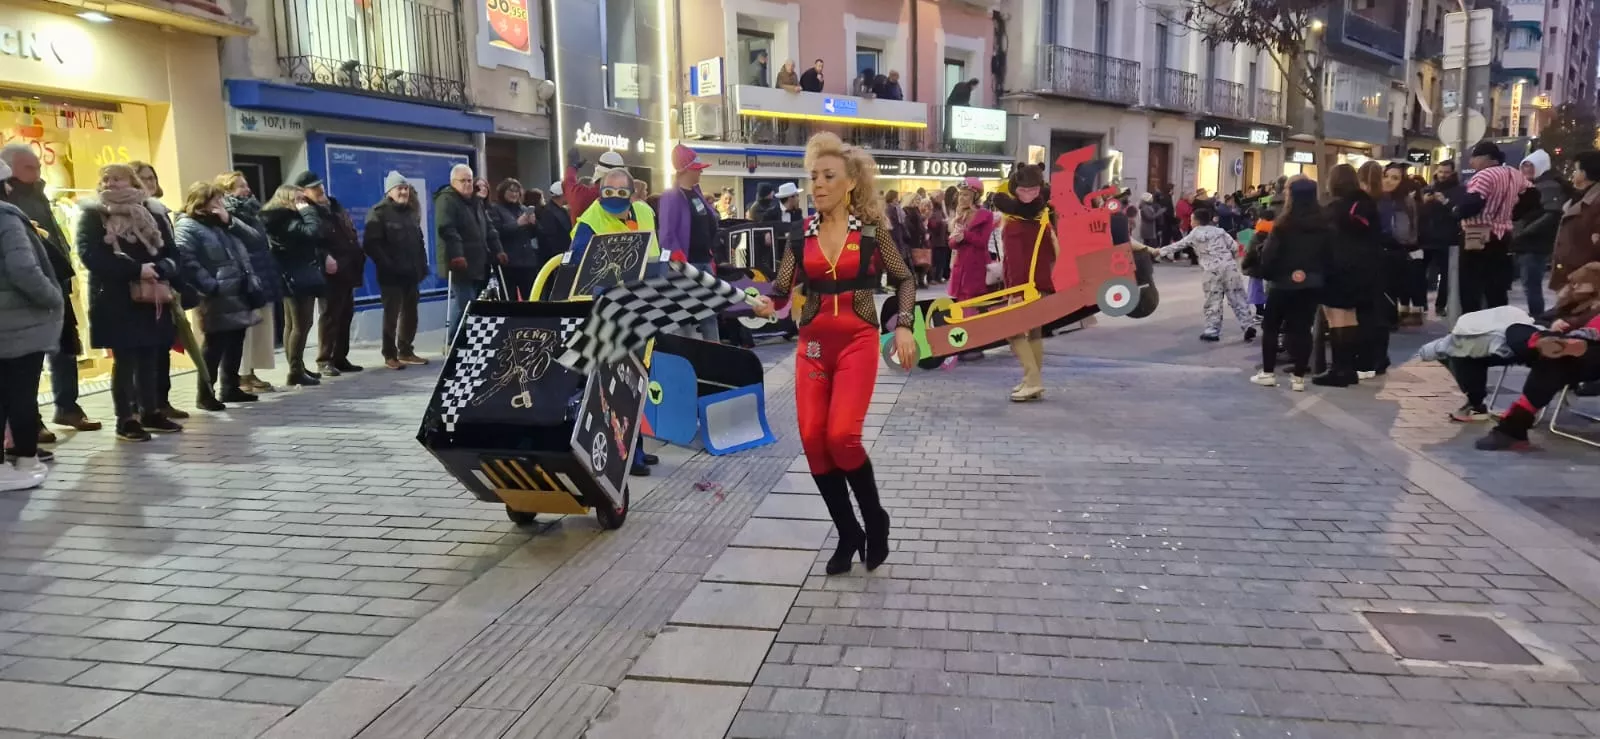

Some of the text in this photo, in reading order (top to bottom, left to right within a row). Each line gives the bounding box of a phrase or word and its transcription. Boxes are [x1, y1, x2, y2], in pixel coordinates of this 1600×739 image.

[1205, 126, 1217, 137] IN
[899, 159, 916, 176] EL
[1110, 251, 1130, 276] 8
[516, 328, 549, 340] PEÑA
